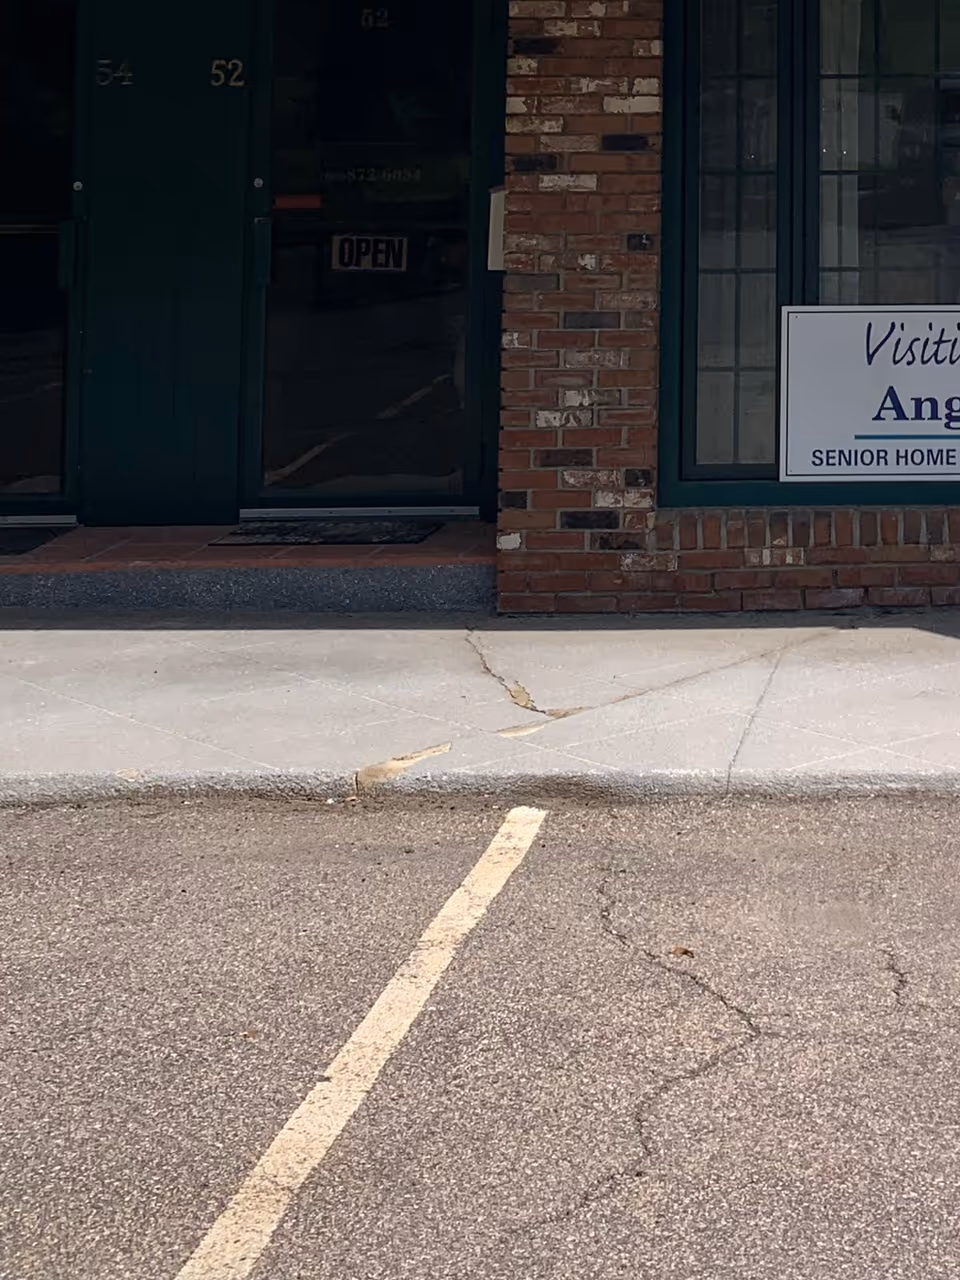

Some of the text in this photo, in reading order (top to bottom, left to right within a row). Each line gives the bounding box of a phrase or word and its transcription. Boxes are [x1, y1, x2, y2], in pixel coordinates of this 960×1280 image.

[95, 57, 134, 86] 54
[210, 58, 245, 86] 52
[338, 237, 403, 268] OPEN
[811, 449, 889, 466] SENIOR
[896, 448, 957, 466] HOME
